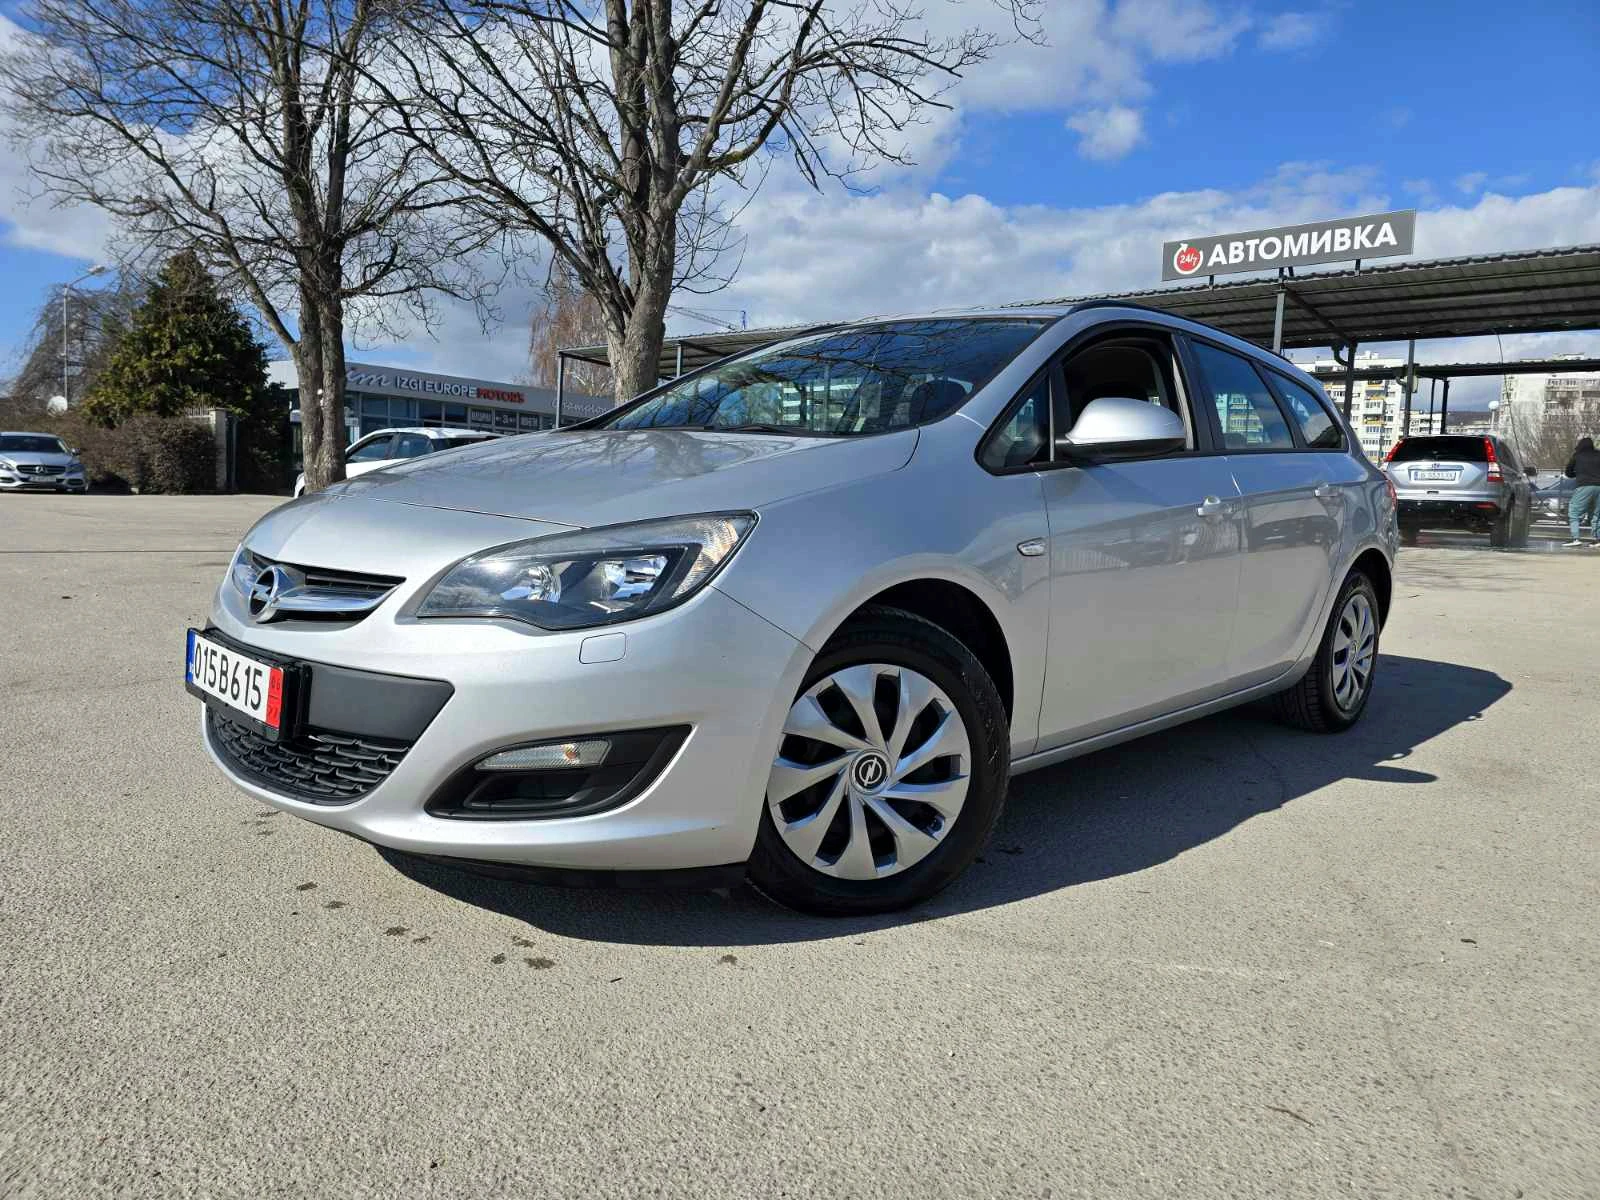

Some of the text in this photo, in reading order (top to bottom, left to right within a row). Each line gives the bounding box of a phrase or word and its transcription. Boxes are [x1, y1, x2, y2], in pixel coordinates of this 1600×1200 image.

[1206, 222, 1398, 268] АВТОМИВКА
[397, 375, 525, 404] IZGI EUROPE MOTORS
[194, 643, 263, 711] 015B615
